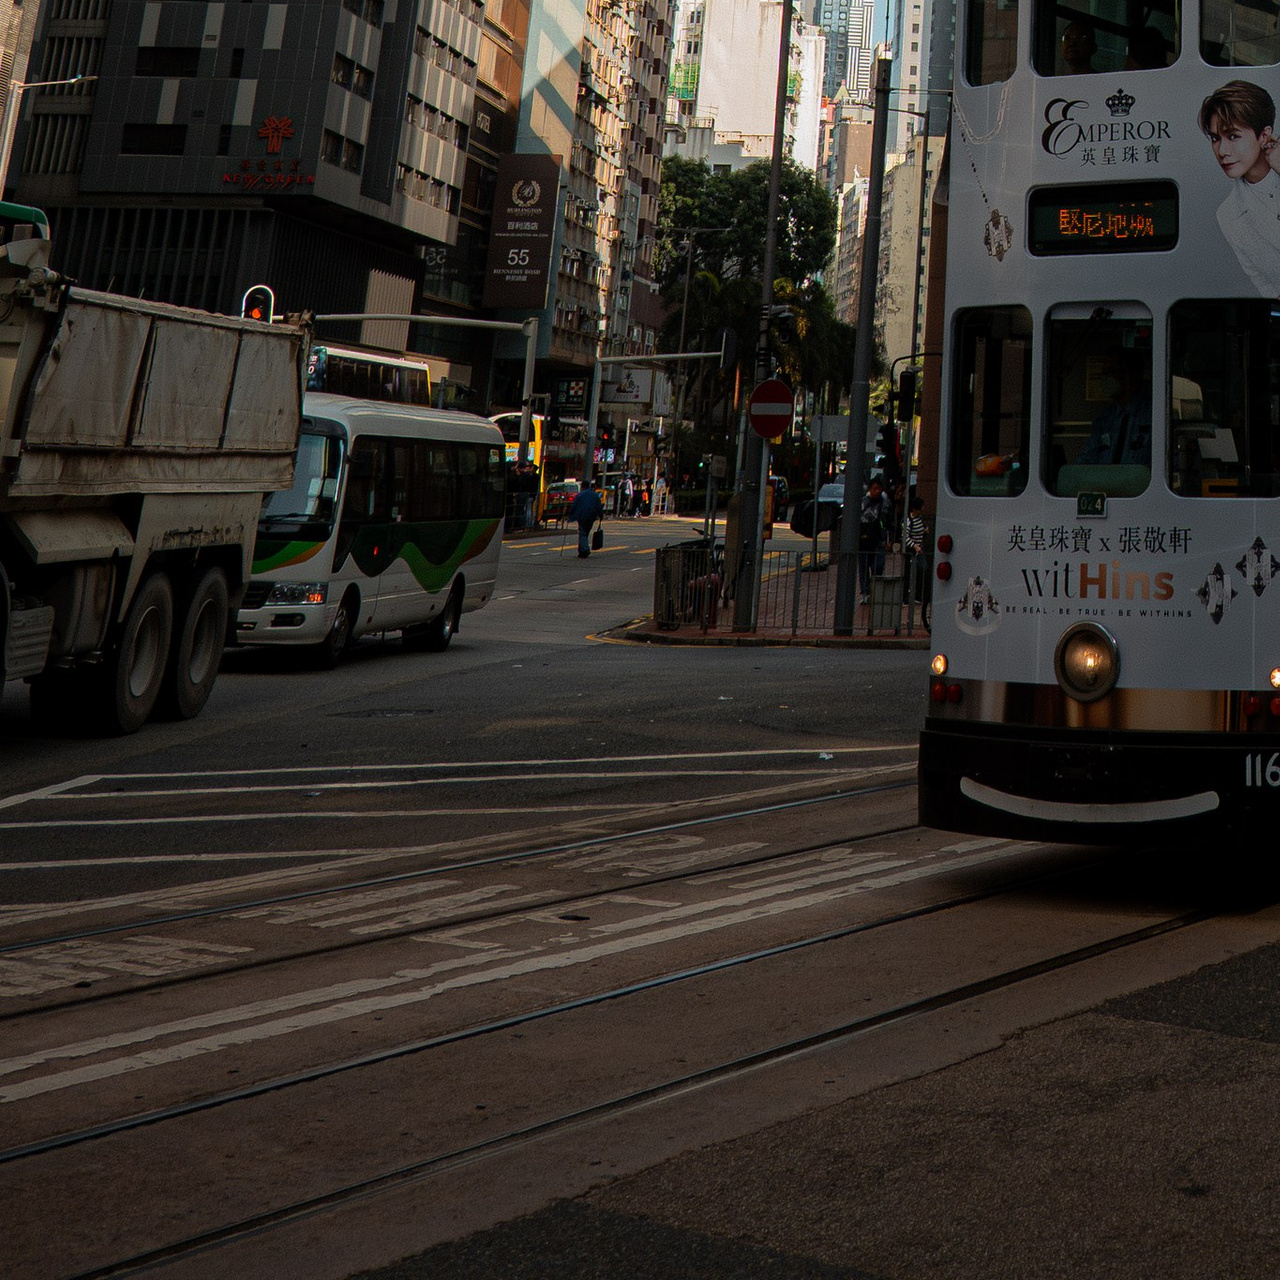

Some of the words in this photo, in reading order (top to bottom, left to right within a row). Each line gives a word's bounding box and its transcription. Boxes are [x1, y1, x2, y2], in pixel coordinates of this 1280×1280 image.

[1080, 143, 1162, 167] 英皇珠寶
[508, 249, 529, 265] 55
[1080, 496, 1103, 511] 024
[1007, 525, 1092, 554] 英皇珠寶
[1100, 539, 1111, 552] x
[1118, 526, 1193, 554] 張敬軒
[1021, 559, 1175, 601] witHins
[1005, 605, 1017, 614] BE
[1022, 606, 1048, 615] REAL
[1058, 607, 1072, 616] BE
[1078, 608, 1106, 617] TRUE
[1118, 609, 1132, 617] BE
[1138, 609, 1193, 618] WITHINS
